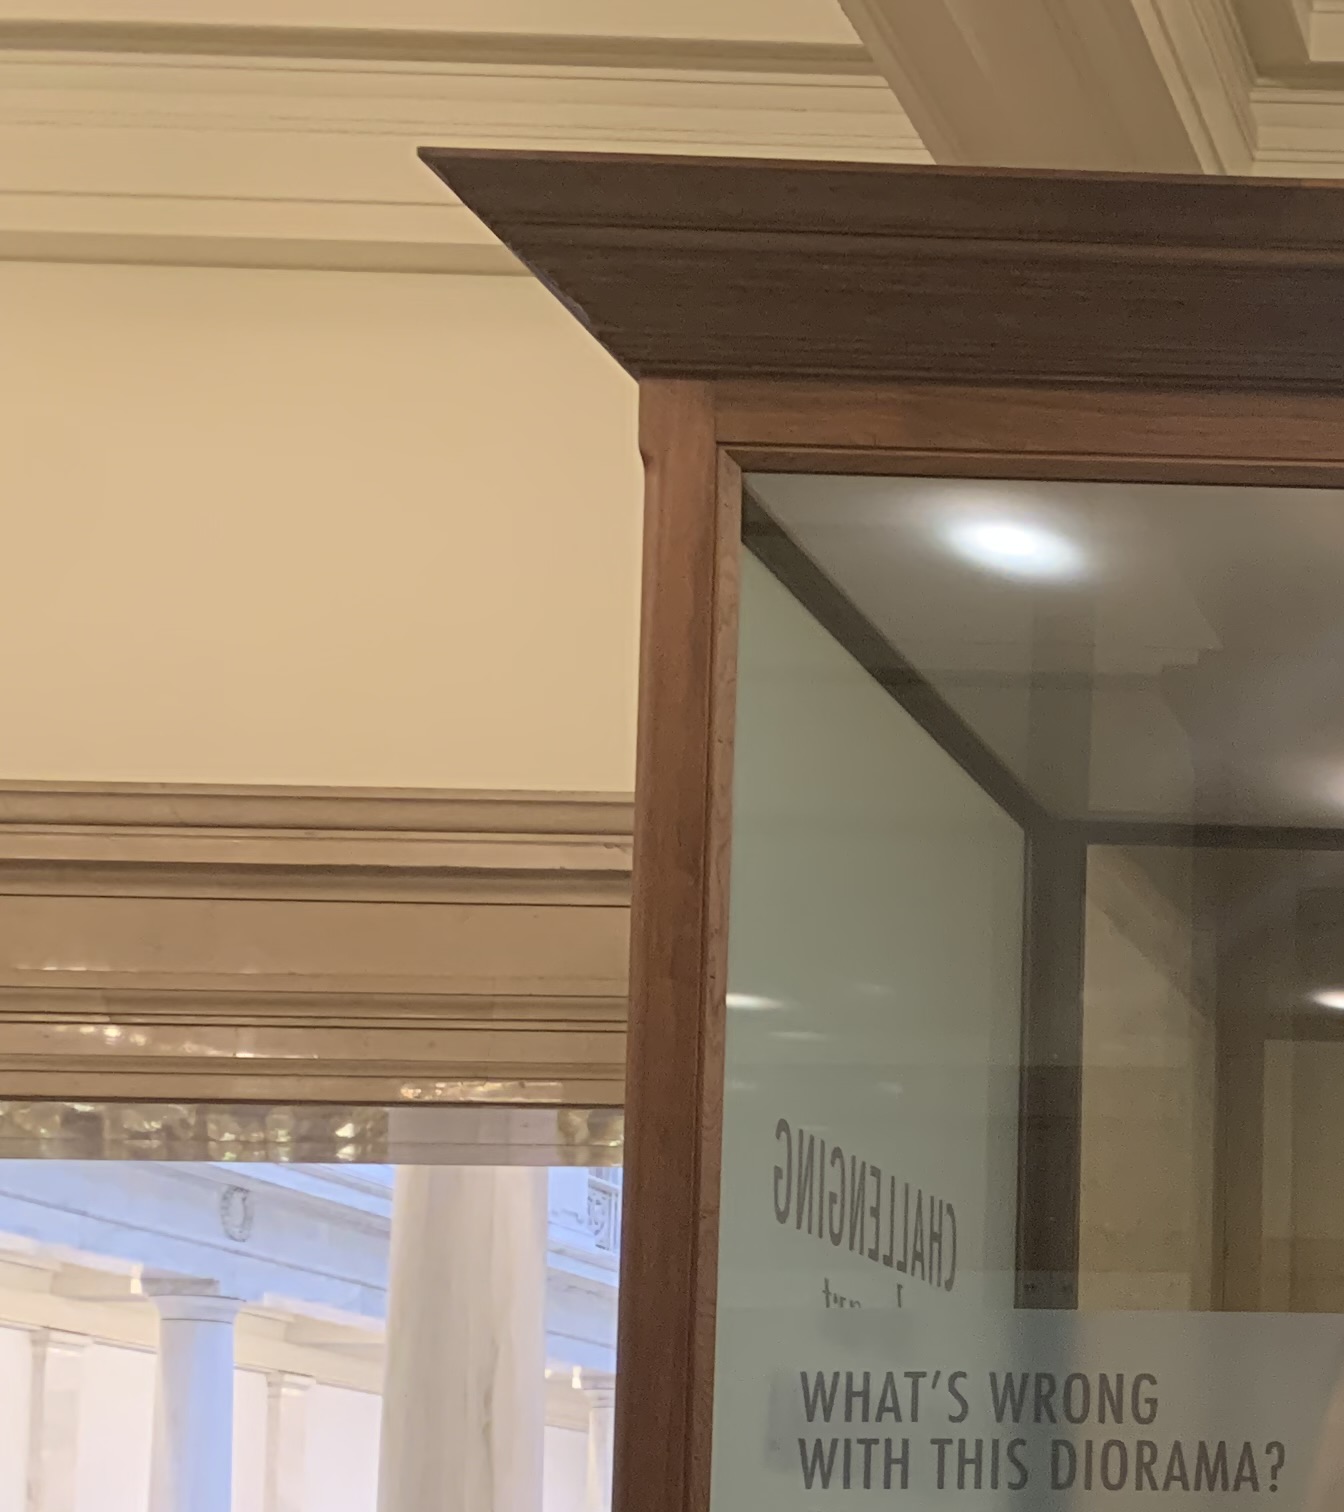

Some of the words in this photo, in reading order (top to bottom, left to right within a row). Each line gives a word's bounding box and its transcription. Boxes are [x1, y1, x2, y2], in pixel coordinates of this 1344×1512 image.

[800, 1369, 968, 1423] WHAT'S
[989, 1371, 1158, 1425] WRONG
[797, 1437, 909, 1490] WITH
[930, 1437, 1028, 1490] THIS
[1050, 1438, 1285, 1492] DIORAMA?
